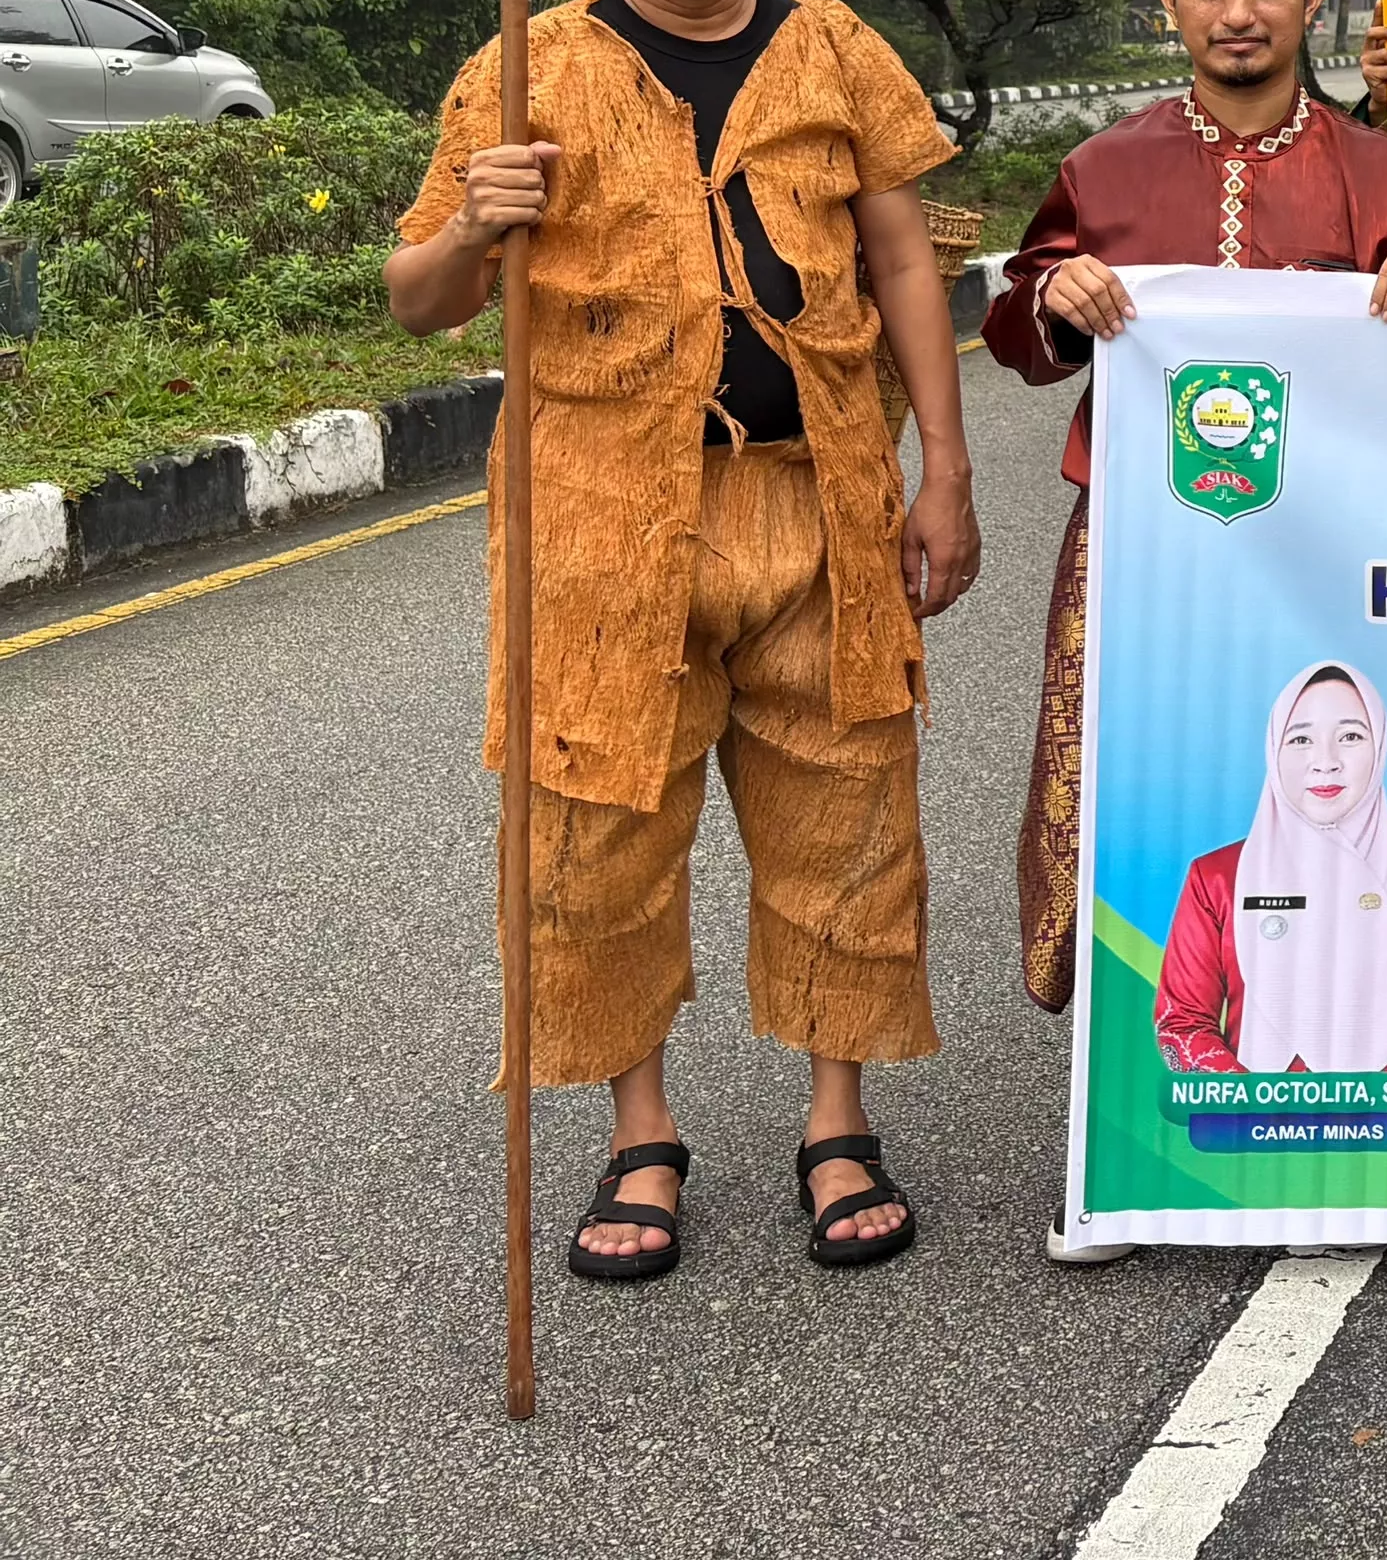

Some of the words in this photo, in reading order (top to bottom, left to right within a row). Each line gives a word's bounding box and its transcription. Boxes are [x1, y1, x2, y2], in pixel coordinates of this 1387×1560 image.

[1206, 471, 1243, 488] SIAK
[1172, 1081, 1249, 1104] NURFA
[1255, 1081, 1376, 1106] OCTOLITA,
[1251, 1125, 1318, 1140] CAMAT
[1323, 1124, 1384, 1140] MINAS
